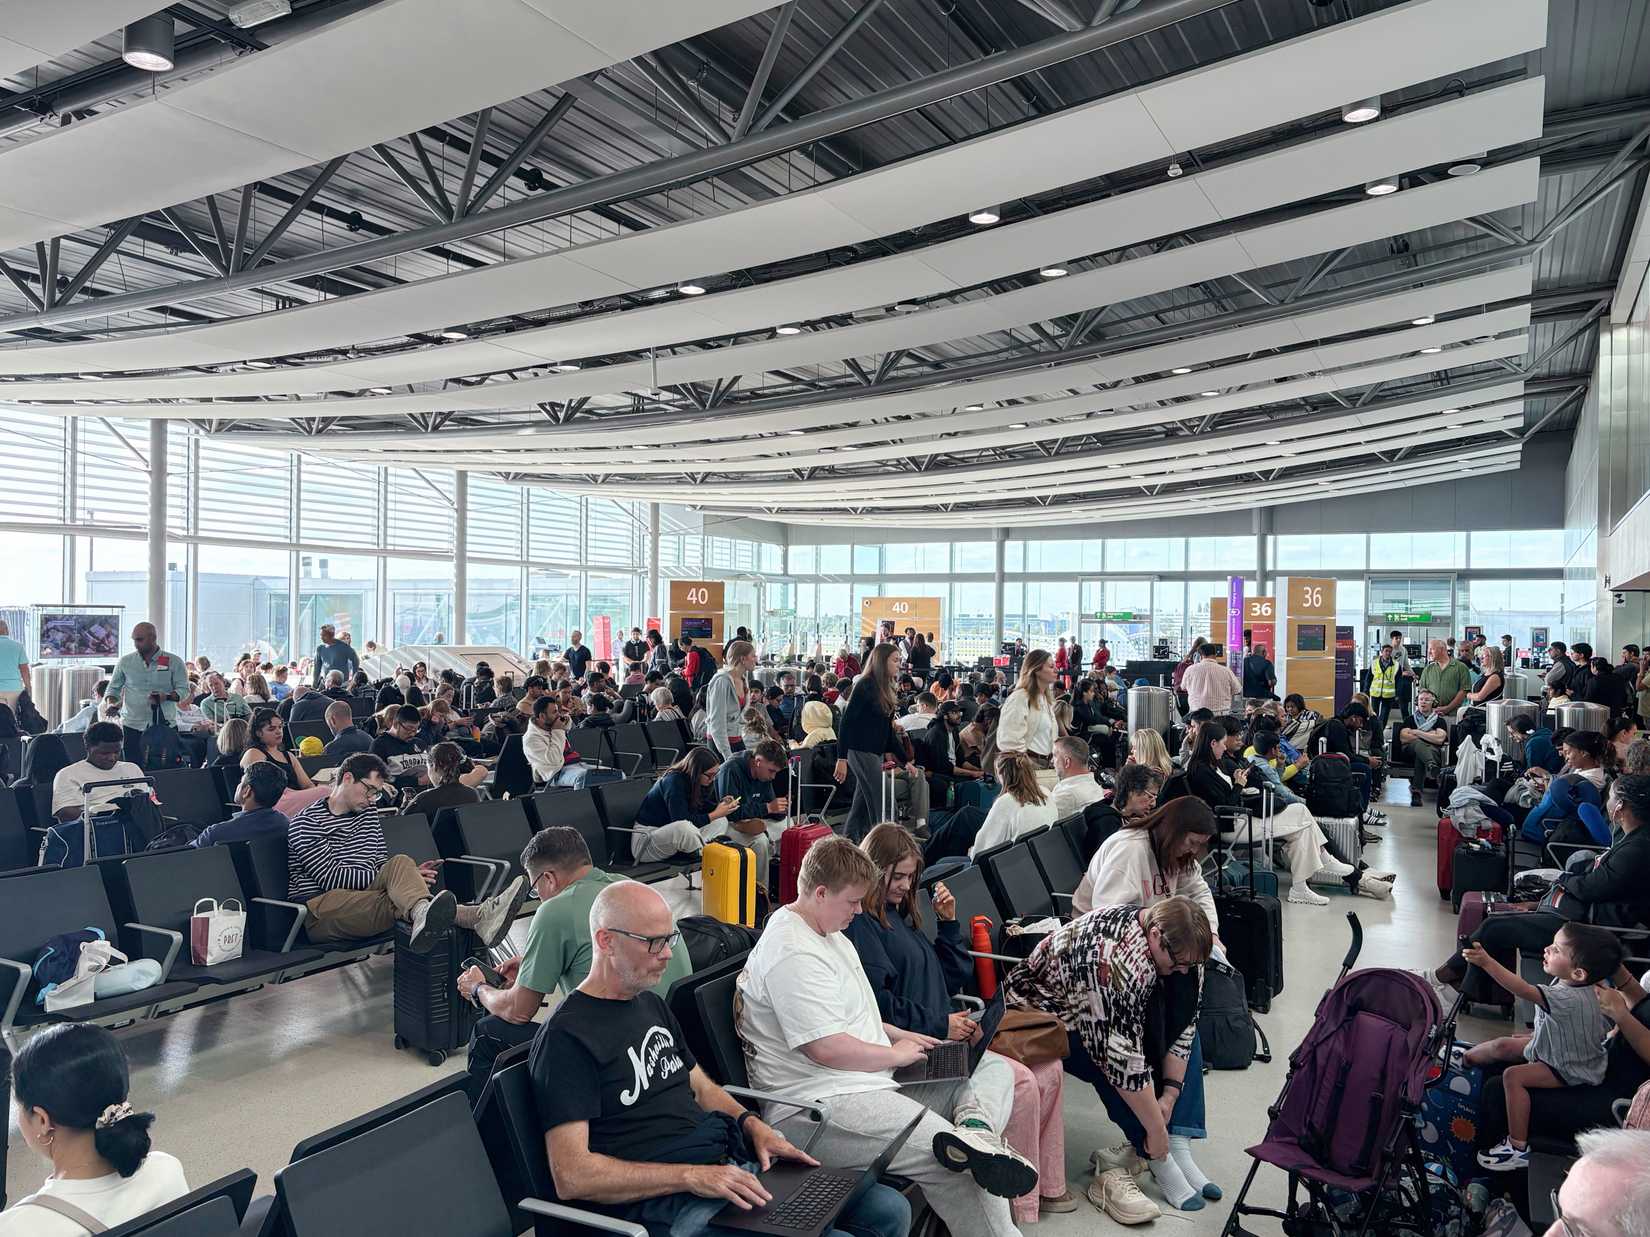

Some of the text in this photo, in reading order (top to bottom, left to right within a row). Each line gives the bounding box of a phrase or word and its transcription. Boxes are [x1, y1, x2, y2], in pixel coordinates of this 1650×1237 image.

[687, 588, 709, 605] 40
[1303, 587, 1322, 607] 36
[892, 602, 909, 614] 40
[1250, 602, 1272, 616] 36
